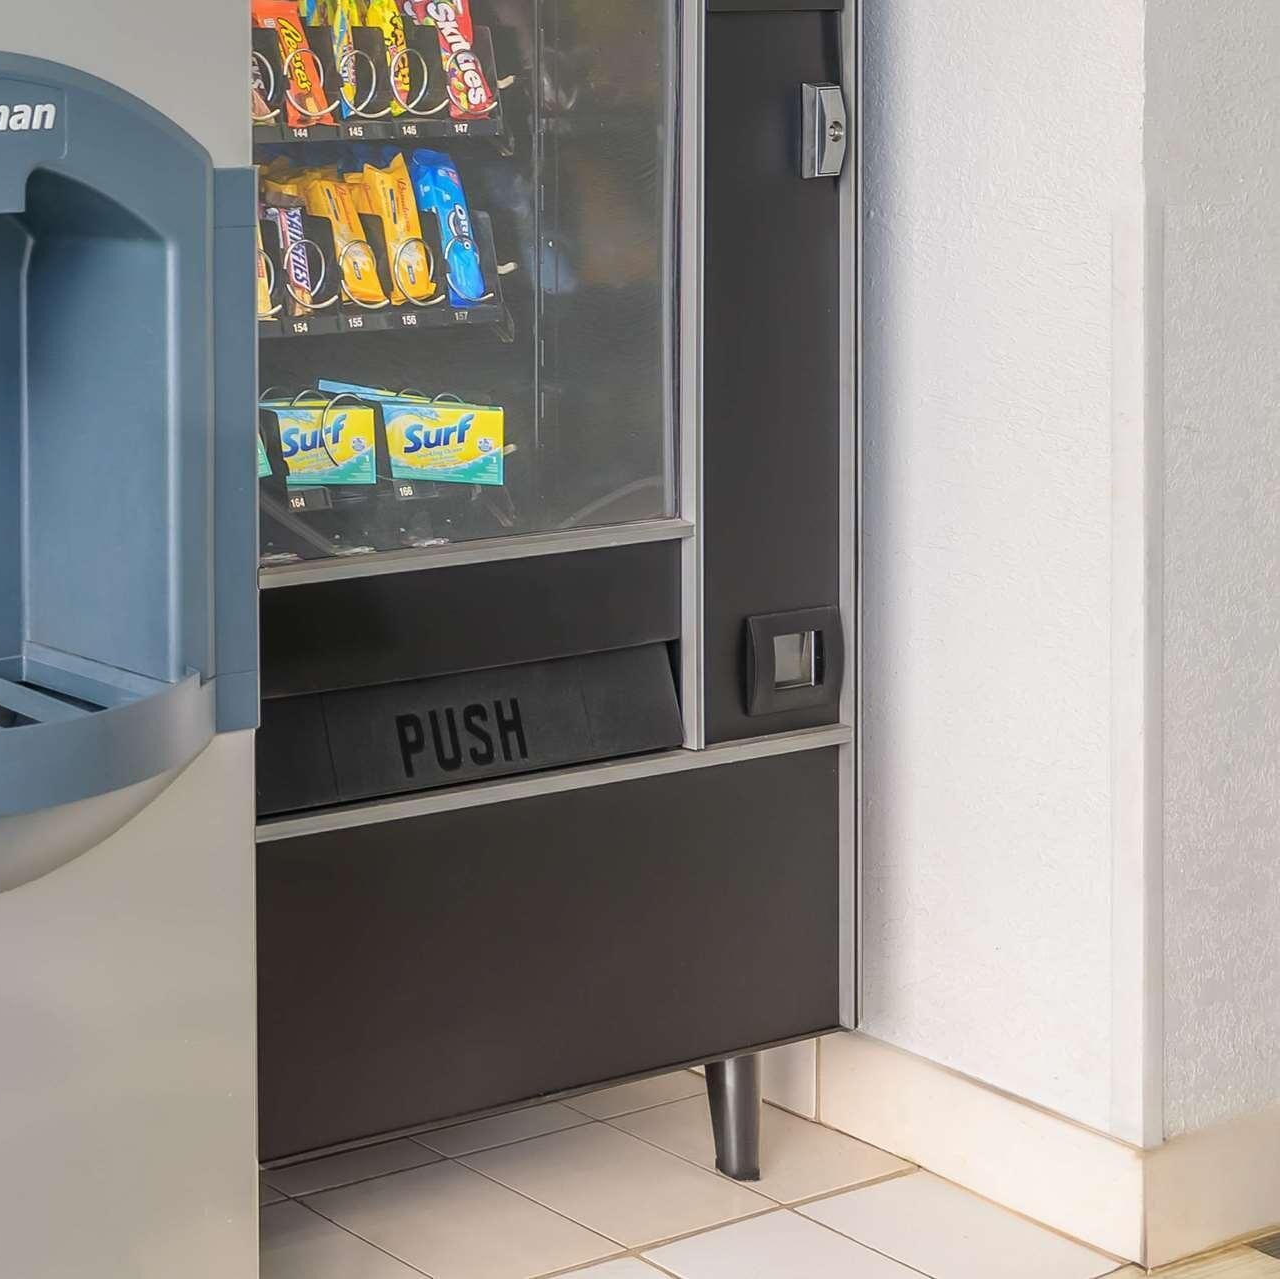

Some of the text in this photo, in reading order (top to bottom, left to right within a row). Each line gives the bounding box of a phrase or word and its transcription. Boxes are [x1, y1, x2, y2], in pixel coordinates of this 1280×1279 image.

[348, 127, 363, 137] 145
[402, 125, 417, 136] 146
[454, 123, 468, 133] 147
[293, 129, 308, 138] 144
[402, 316, 417, 326] 156
[454, 312, 468, 322] 157
[293, 323, 308, 333] 154
[348, 318, 363, 328] 155
[282, 413, 347, 458] Surf
[404, 413, 476, 454] Surf
[291, 497, 305, 508] 164
[395, 697, 529, 778] PUSH
